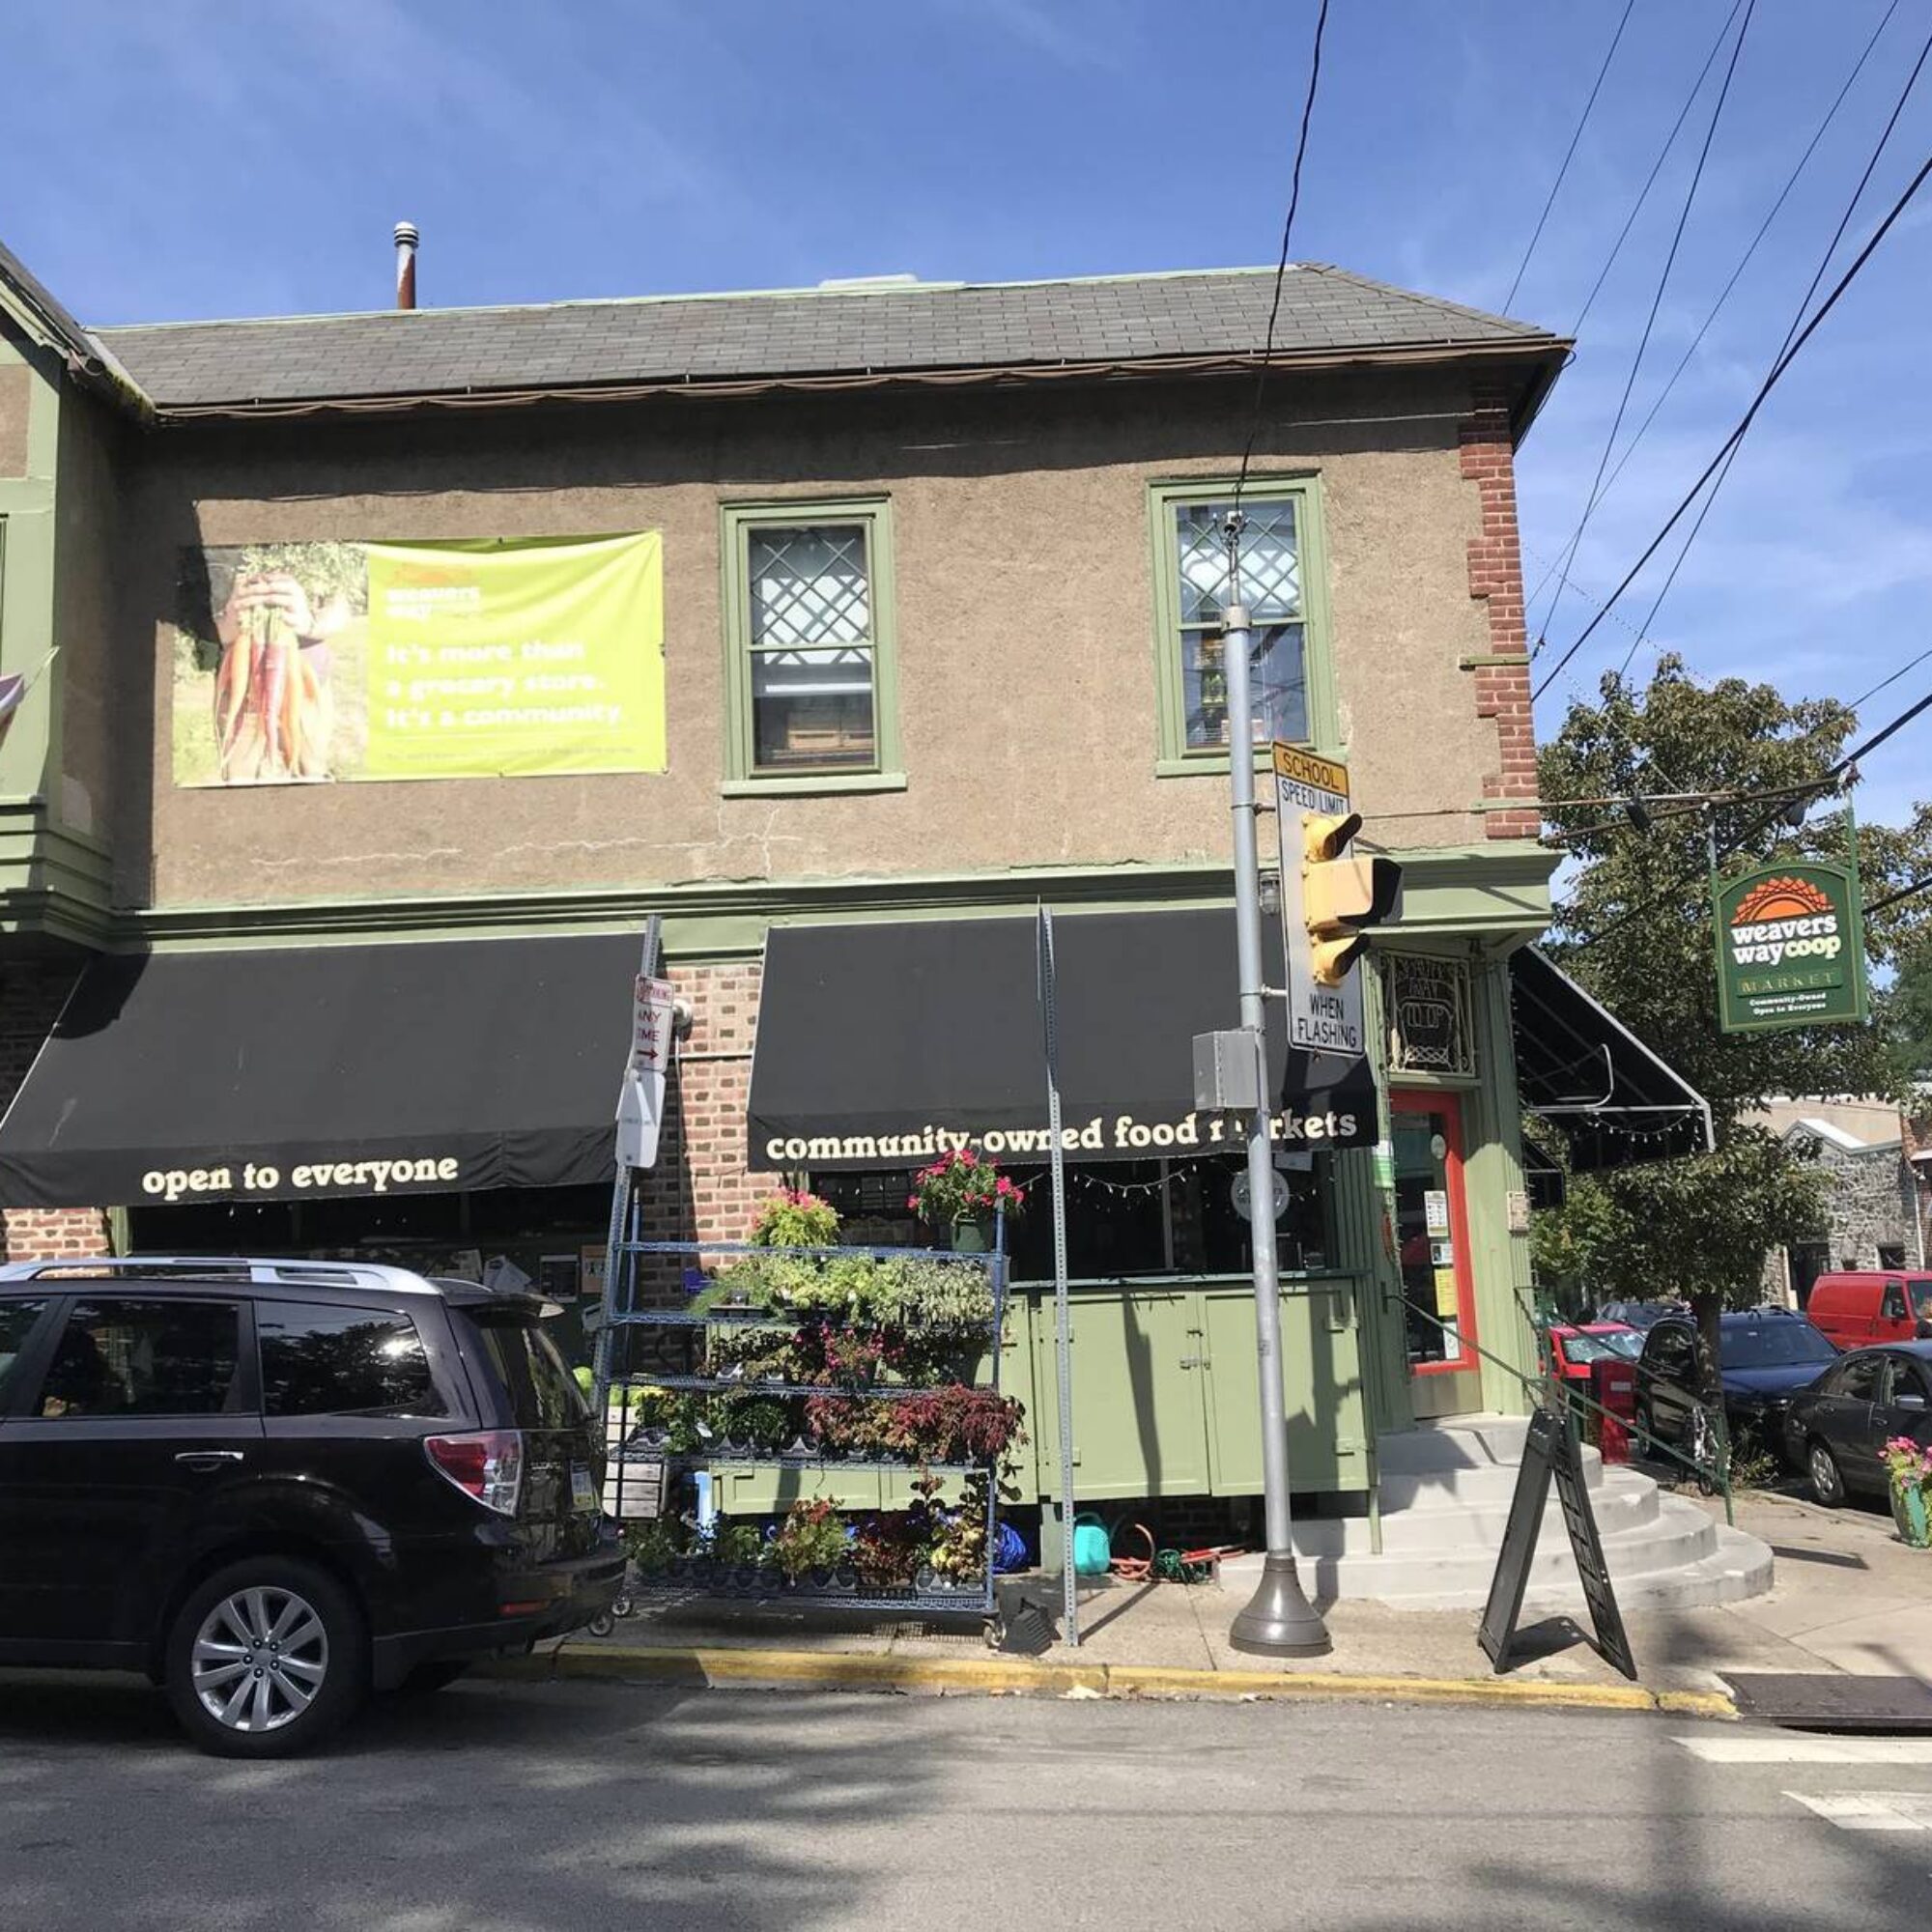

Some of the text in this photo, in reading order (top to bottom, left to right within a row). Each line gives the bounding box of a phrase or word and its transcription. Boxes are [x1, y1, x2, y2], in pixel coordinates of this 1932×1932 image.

[386, 639, 585, 664] It's more than
[408, 676, 515, 702] grocery
[386, 707, 432, 728] It's
[439, 710, 456, 727] a
[1283, 752, 1340, 790] SCHOOL
[1281, 780, 1345, 815] SPEED LIMIT
[1731, 914, 1838, 945] weavers
[1742, 972, 1834, 993] MARKET
[1309, 993, 1344, 1020] WHEN
[1752, 1007, 1775, 1016] Open
[1787, 1002, 1827, 1012] Everyone
[1297, 1017, 1357, 1048] FLASHING
[766, 1108, 1358, 1160] community-owned food mrkets
[141, 1157, 459, 1201] open to everyone
